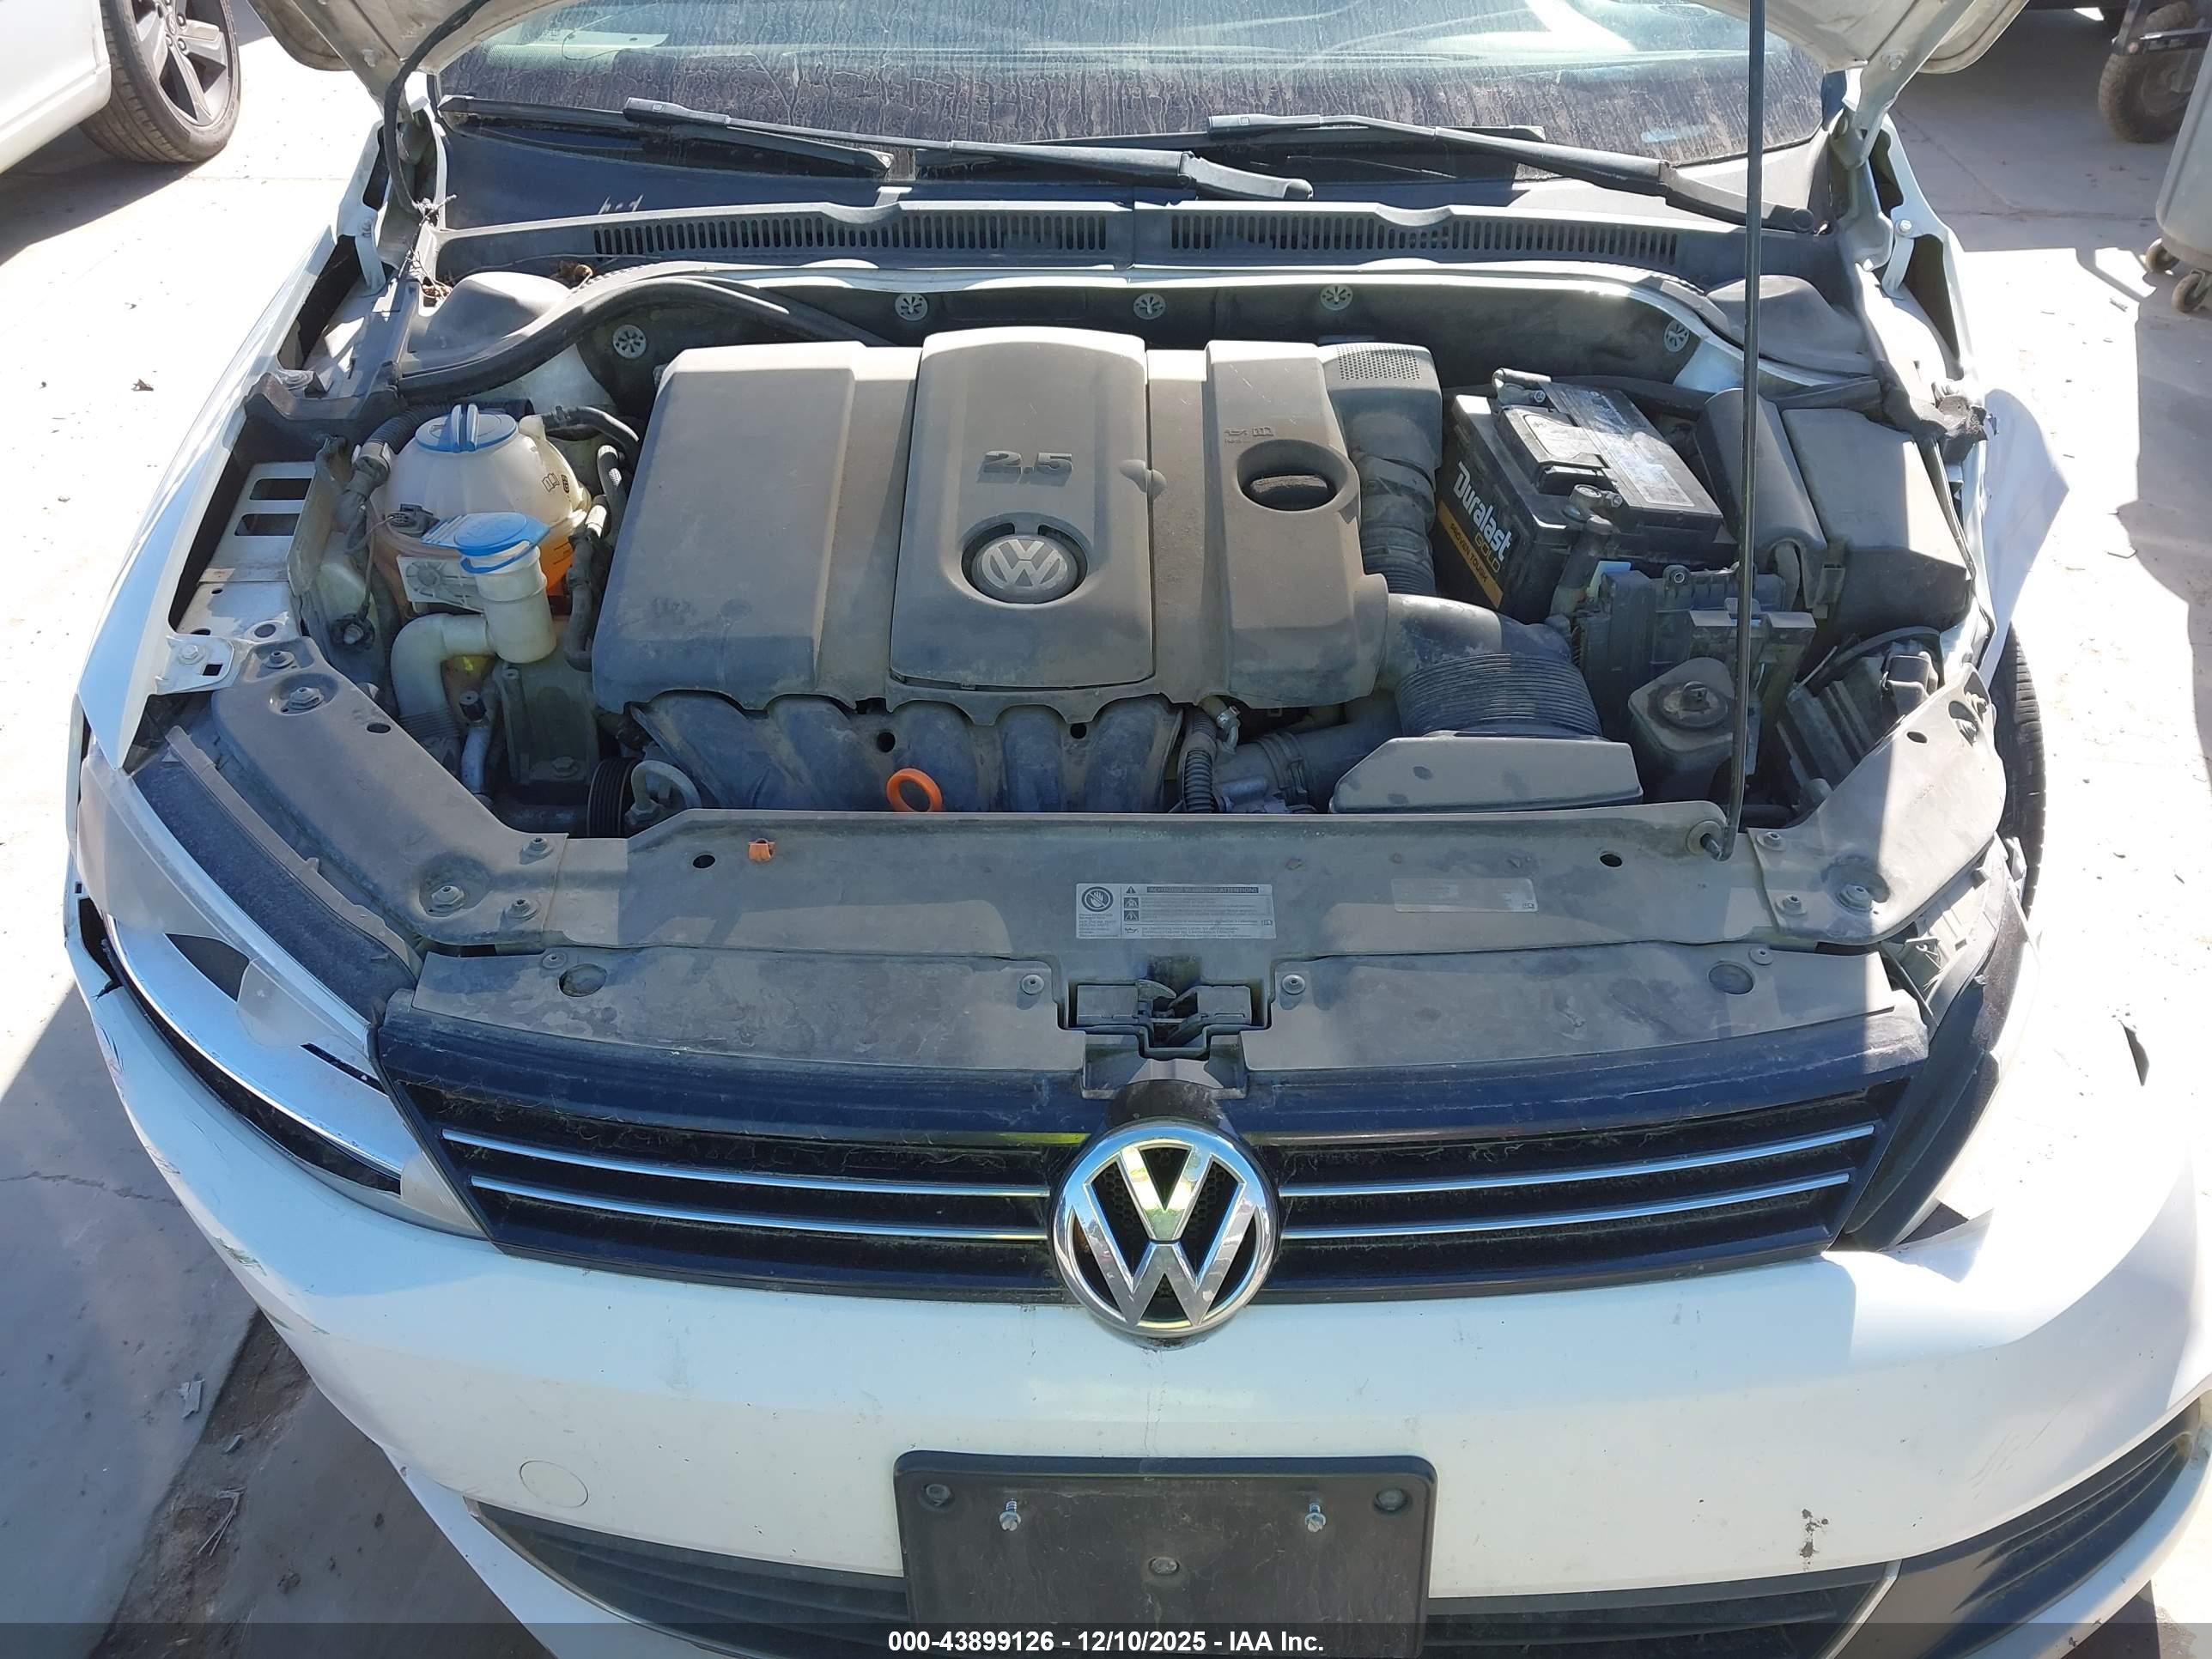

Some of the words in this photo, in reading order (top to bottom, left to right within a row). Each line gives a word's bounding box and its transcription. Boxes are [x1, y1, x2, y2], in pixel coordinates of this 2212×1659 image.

[982, 449, 1073, 475] 2.5
[1453, 460, 1512, 562] Duralast
[1449, 522, 1470, 556] PROVEN
[1468, 552, 1489, 584] TOUGH
[1474, 532, 1501, 574] GOLD
